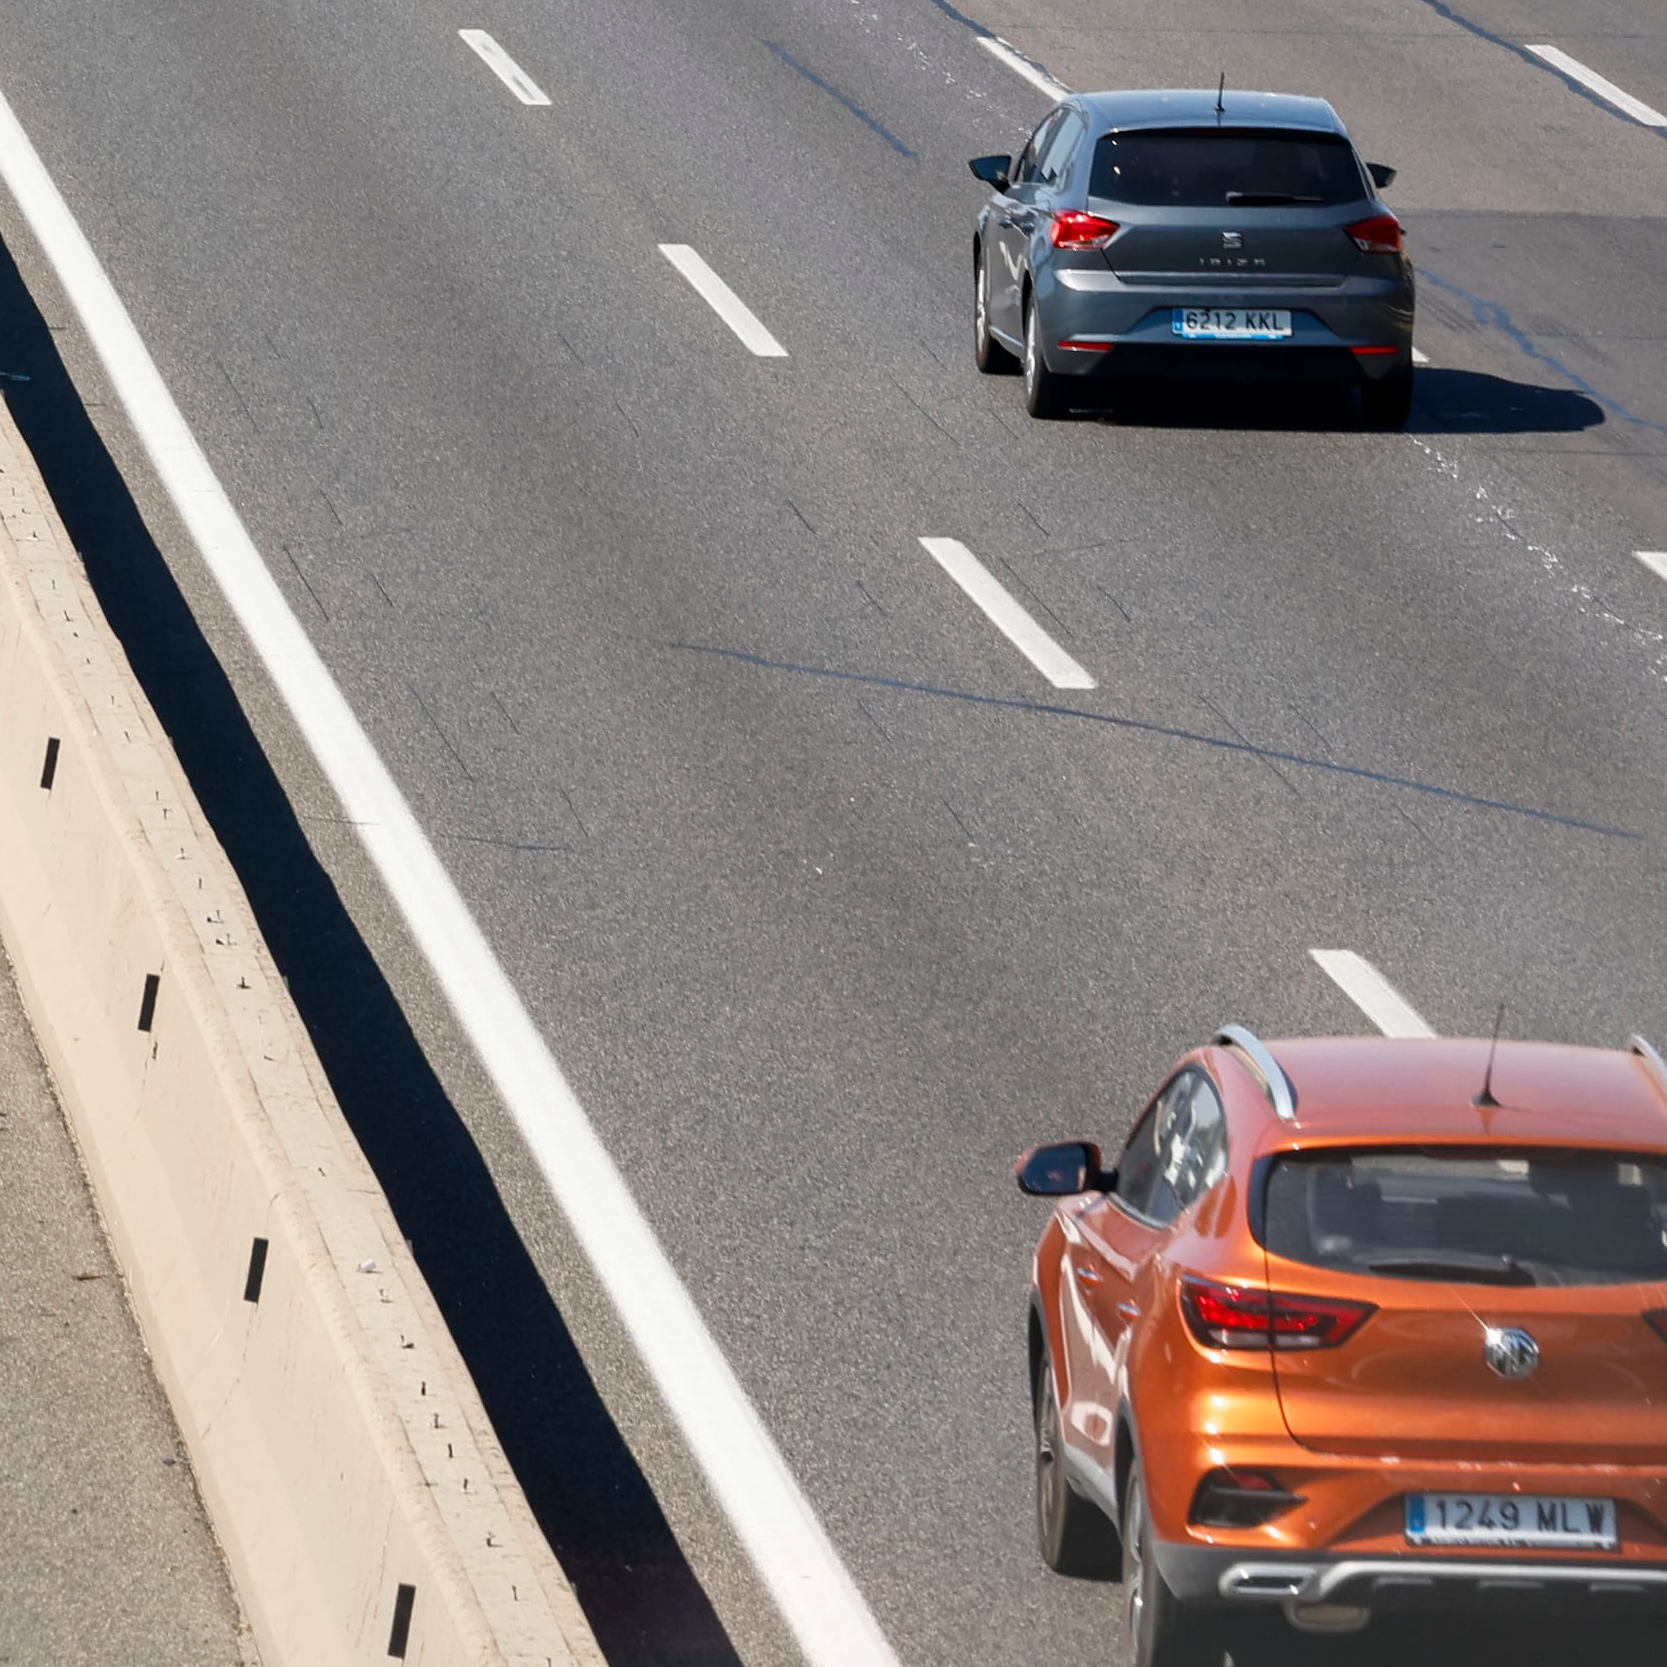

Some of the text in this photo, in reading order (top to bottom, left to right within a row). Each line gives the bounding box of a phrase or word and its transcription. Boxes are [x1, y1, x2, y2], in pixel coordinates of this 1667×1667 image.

[1186, 311, 1285, 331] 6212 KKL
[1436, 1499, 1606, 1534] 1249 MLW
